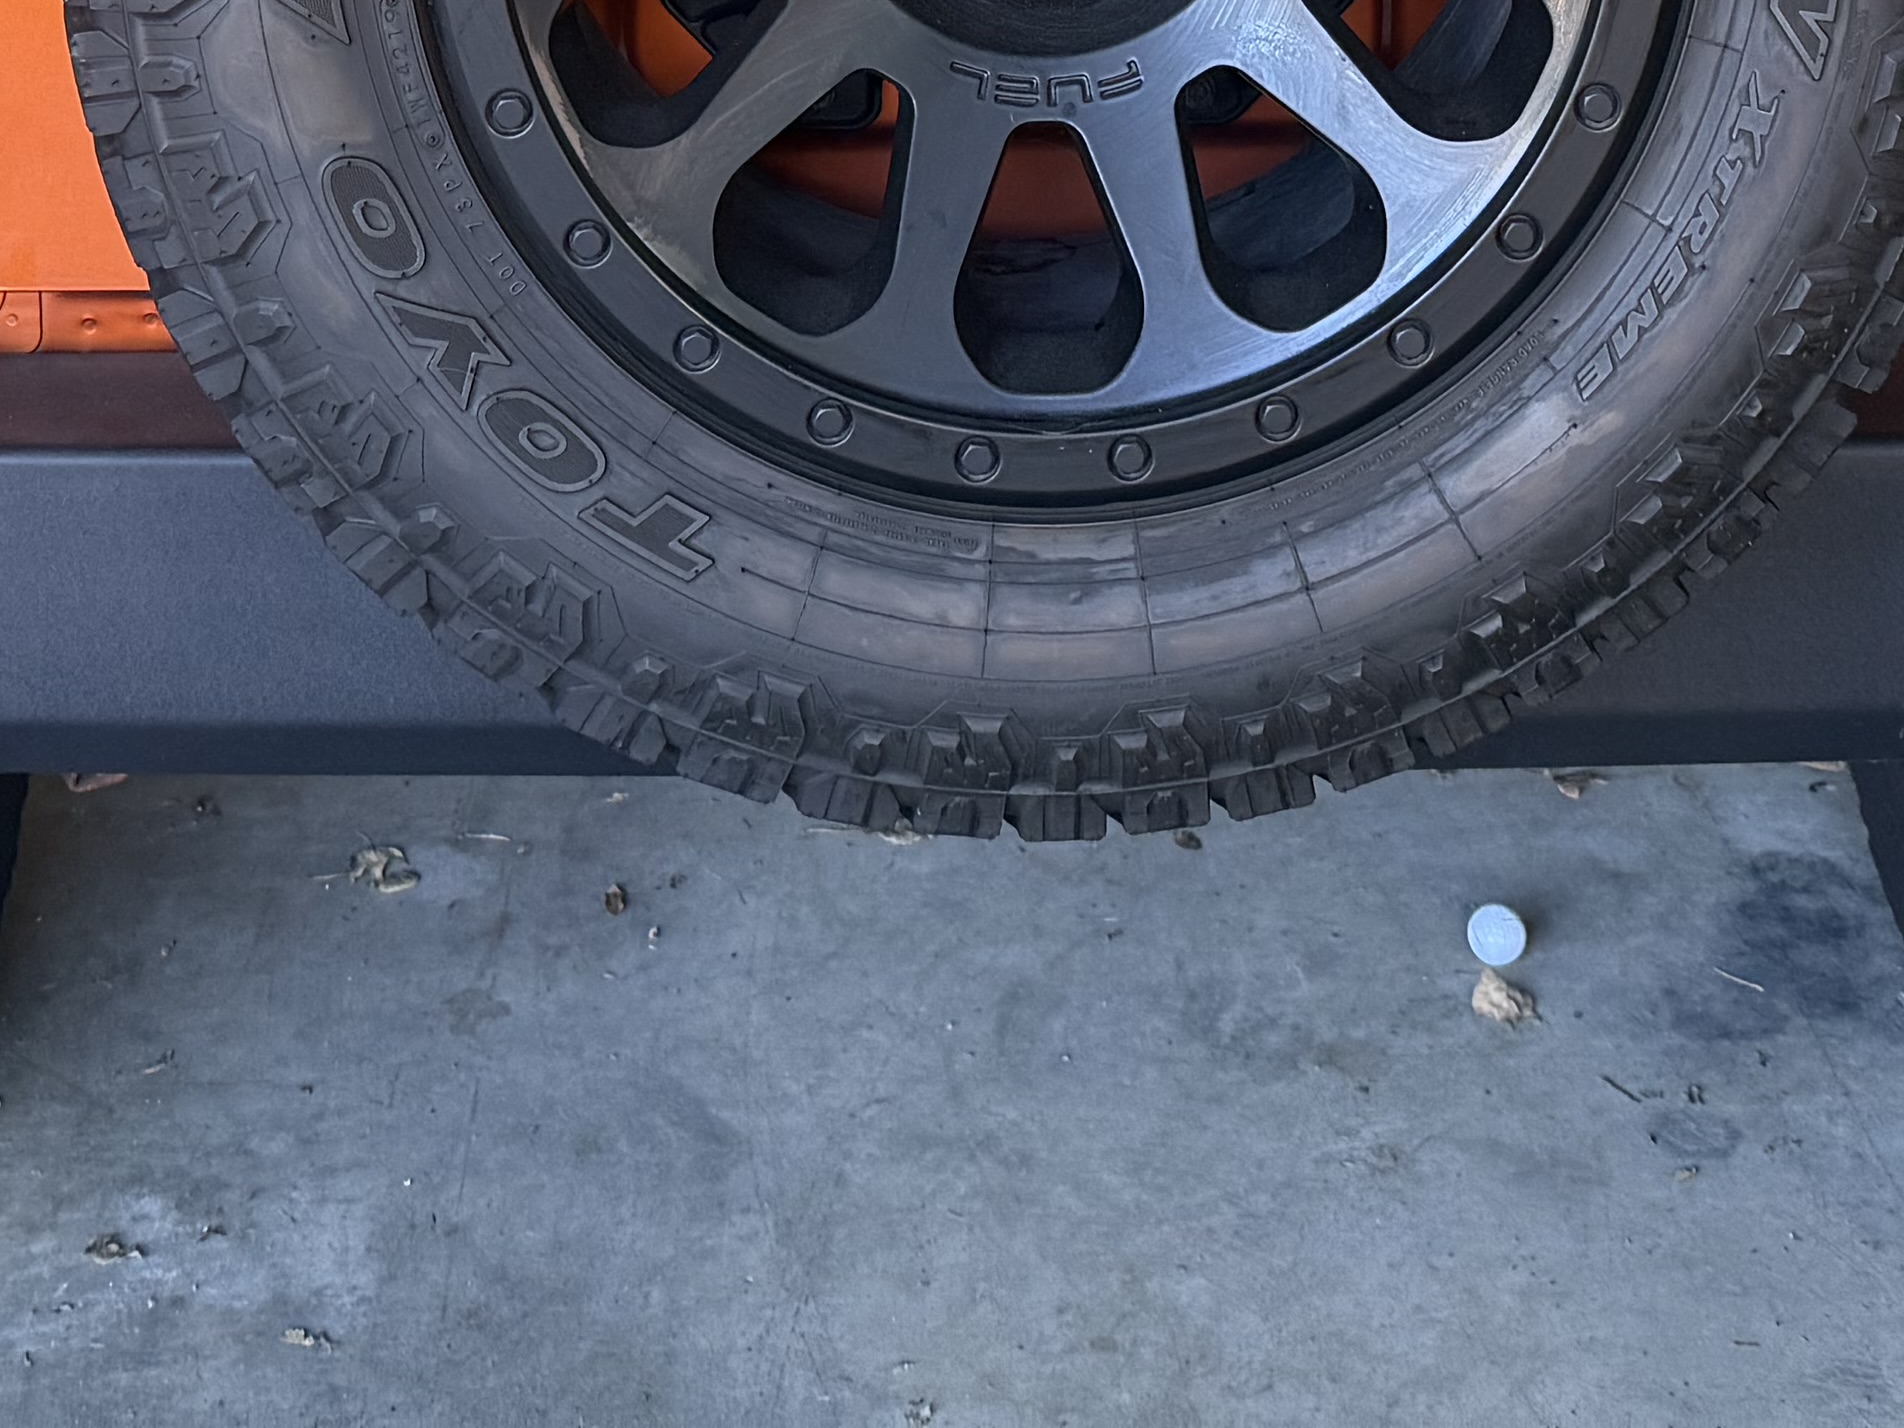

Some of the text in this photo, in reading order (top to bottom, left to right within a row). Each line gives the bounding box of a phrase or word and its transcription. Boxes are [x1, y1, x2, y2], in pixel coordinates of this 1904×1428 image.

[949, 57, 1145, 108] FUEL
[489, 251, 527, 296] DOT
[1574, 70, 1780, 402] XTREME
[321, 156, 715, 582] TOYO
